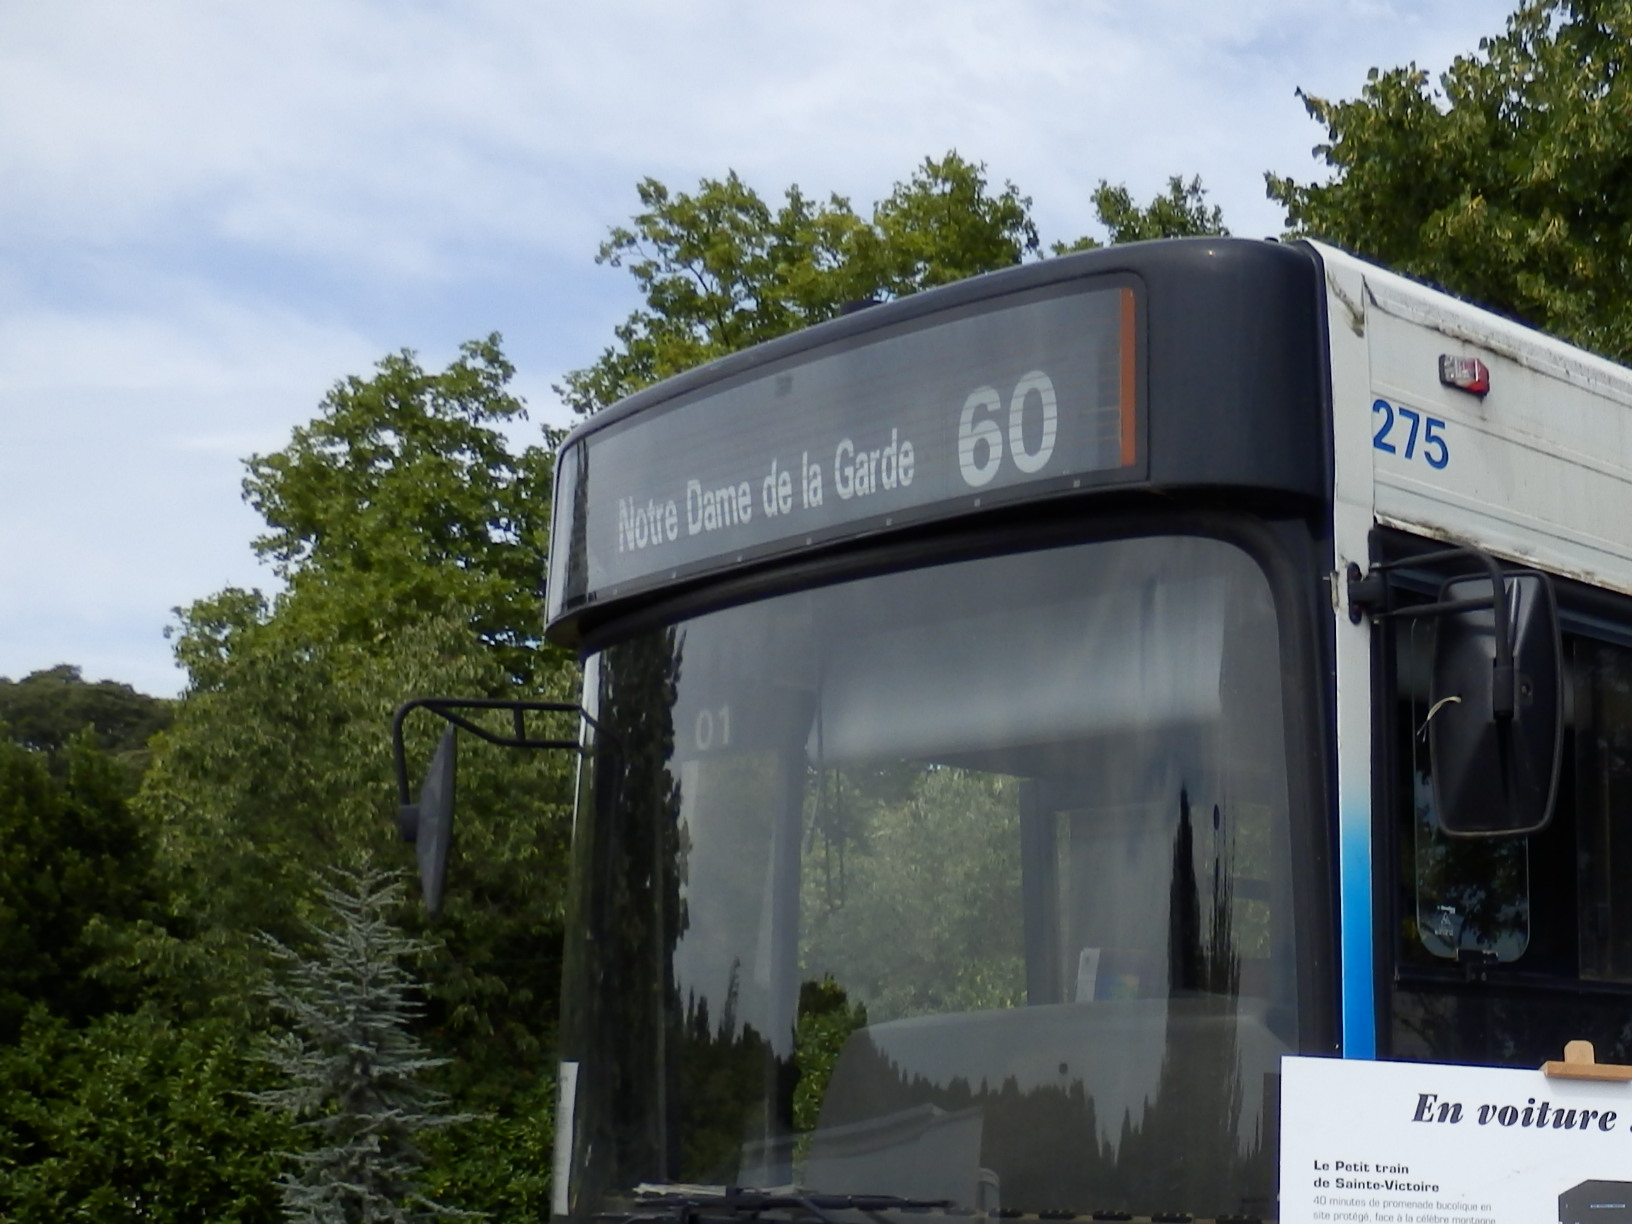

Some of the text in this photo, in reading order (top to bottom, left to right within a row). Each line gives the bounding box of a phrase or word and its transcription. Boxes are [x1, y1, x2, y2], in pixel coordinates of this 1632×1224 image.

[958, 368, 1057, 488] 60
[1372, 398, 1449, 470] 275
[618, 427, 915, 552] Notre Dame de la Garde
[1411, 1093, 1464, 1124] En
[1477, 1097, 1617, 1132] voiture
[1313, 1159, 1409, 1174] Le Petit train
[1313, 1177, 1440, 1193] de Sainte-Victoire
[1313, 1195, 1492, 1213] 40 minutes de promenade bucolique en
[1313, 1210, 1330, 1220] site
[1333, 1212, 1372, 1223] protégé,
[1375, 1212, 1394, 1222] face
[1397, 1213, 1402, 1223] à
[1405, 1213, 1413, 1223] la
[1416, 1213, 1449, 1224] célèbre
